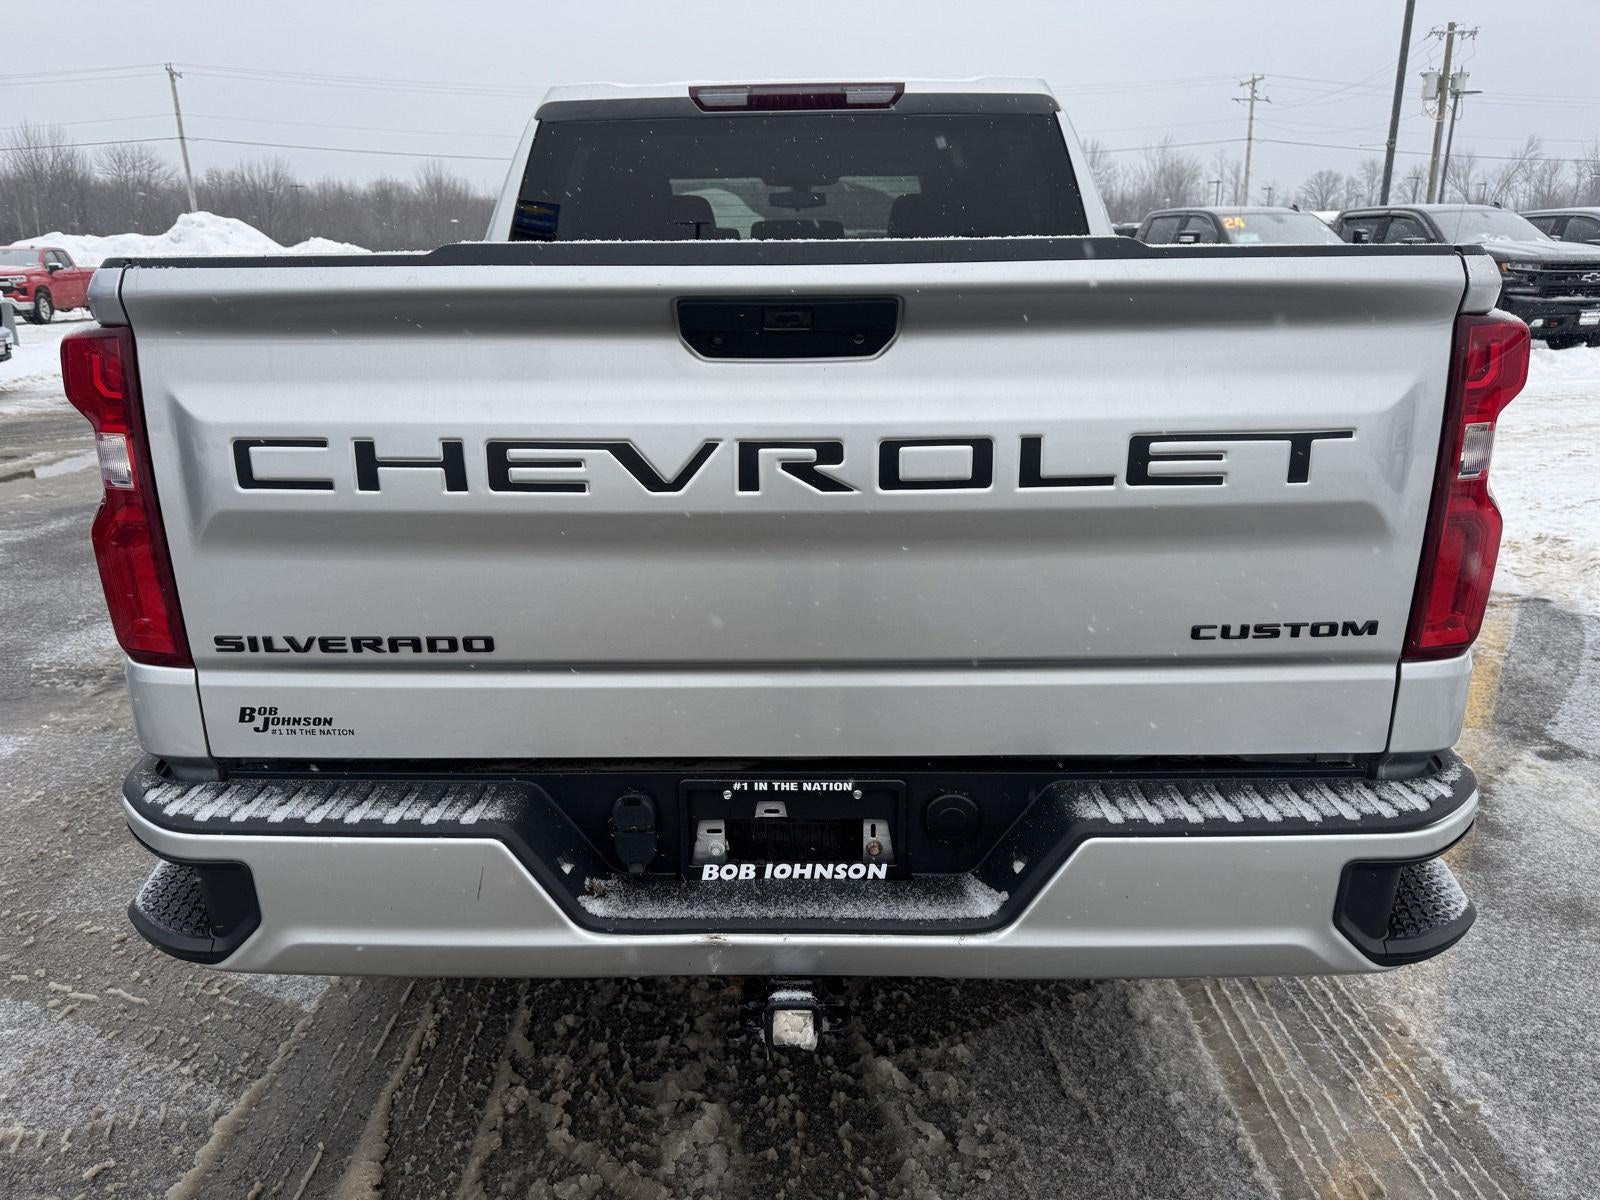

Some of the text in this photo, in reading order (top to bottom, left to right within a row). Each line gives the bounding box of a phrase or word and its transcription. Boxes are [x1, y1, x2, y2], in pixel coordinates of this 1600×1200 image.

[232, 428, 1356, 494] CHEVROLET
[1190, 620, 1379, 641] CUSTOM
[213, 635, 495, 653] SILVERADO
[238, 706, 278, 723] BOB
[253, 716, 333, 733] JOHNSON
[271, 728, 355, 736] #1 IN THE NATION
[732, 782, 853, 791] #1 IN THE NATION
[701, 863, 756, 881] BOB
